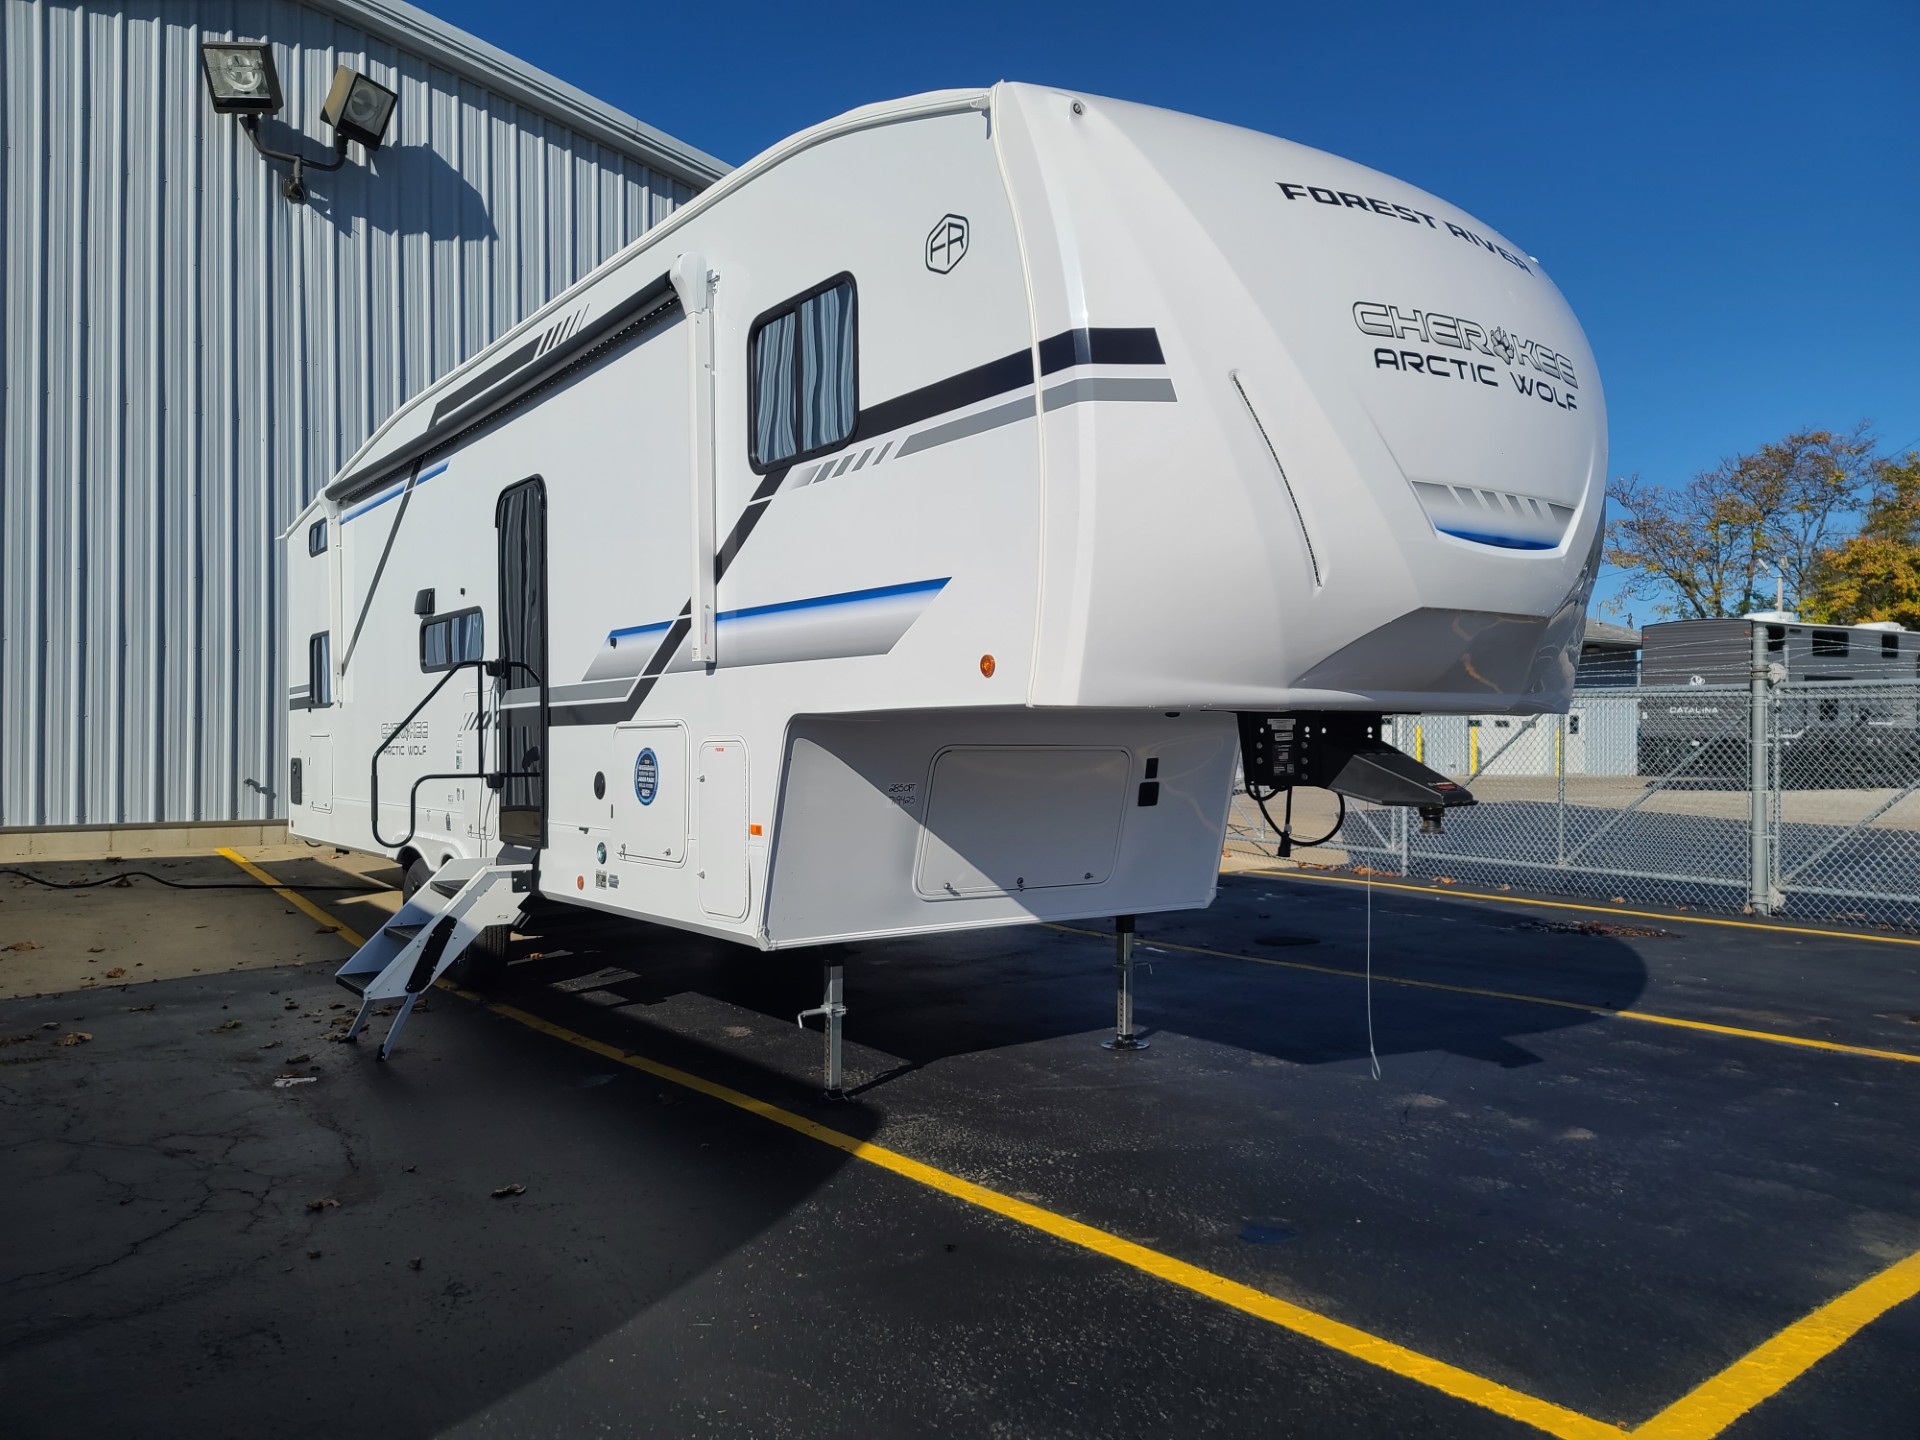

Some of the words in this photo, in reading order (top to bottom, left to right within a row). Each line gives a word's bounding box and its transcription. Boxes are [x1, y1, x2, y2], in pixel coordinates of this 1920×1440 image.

[1275, 181, 1437, 229] FOREST
[1442, 220, 1536, 278] RIVER
[1374, 347, 1499, 387] ARCTIC
[1509, 371, 1578, 411] WOLF
